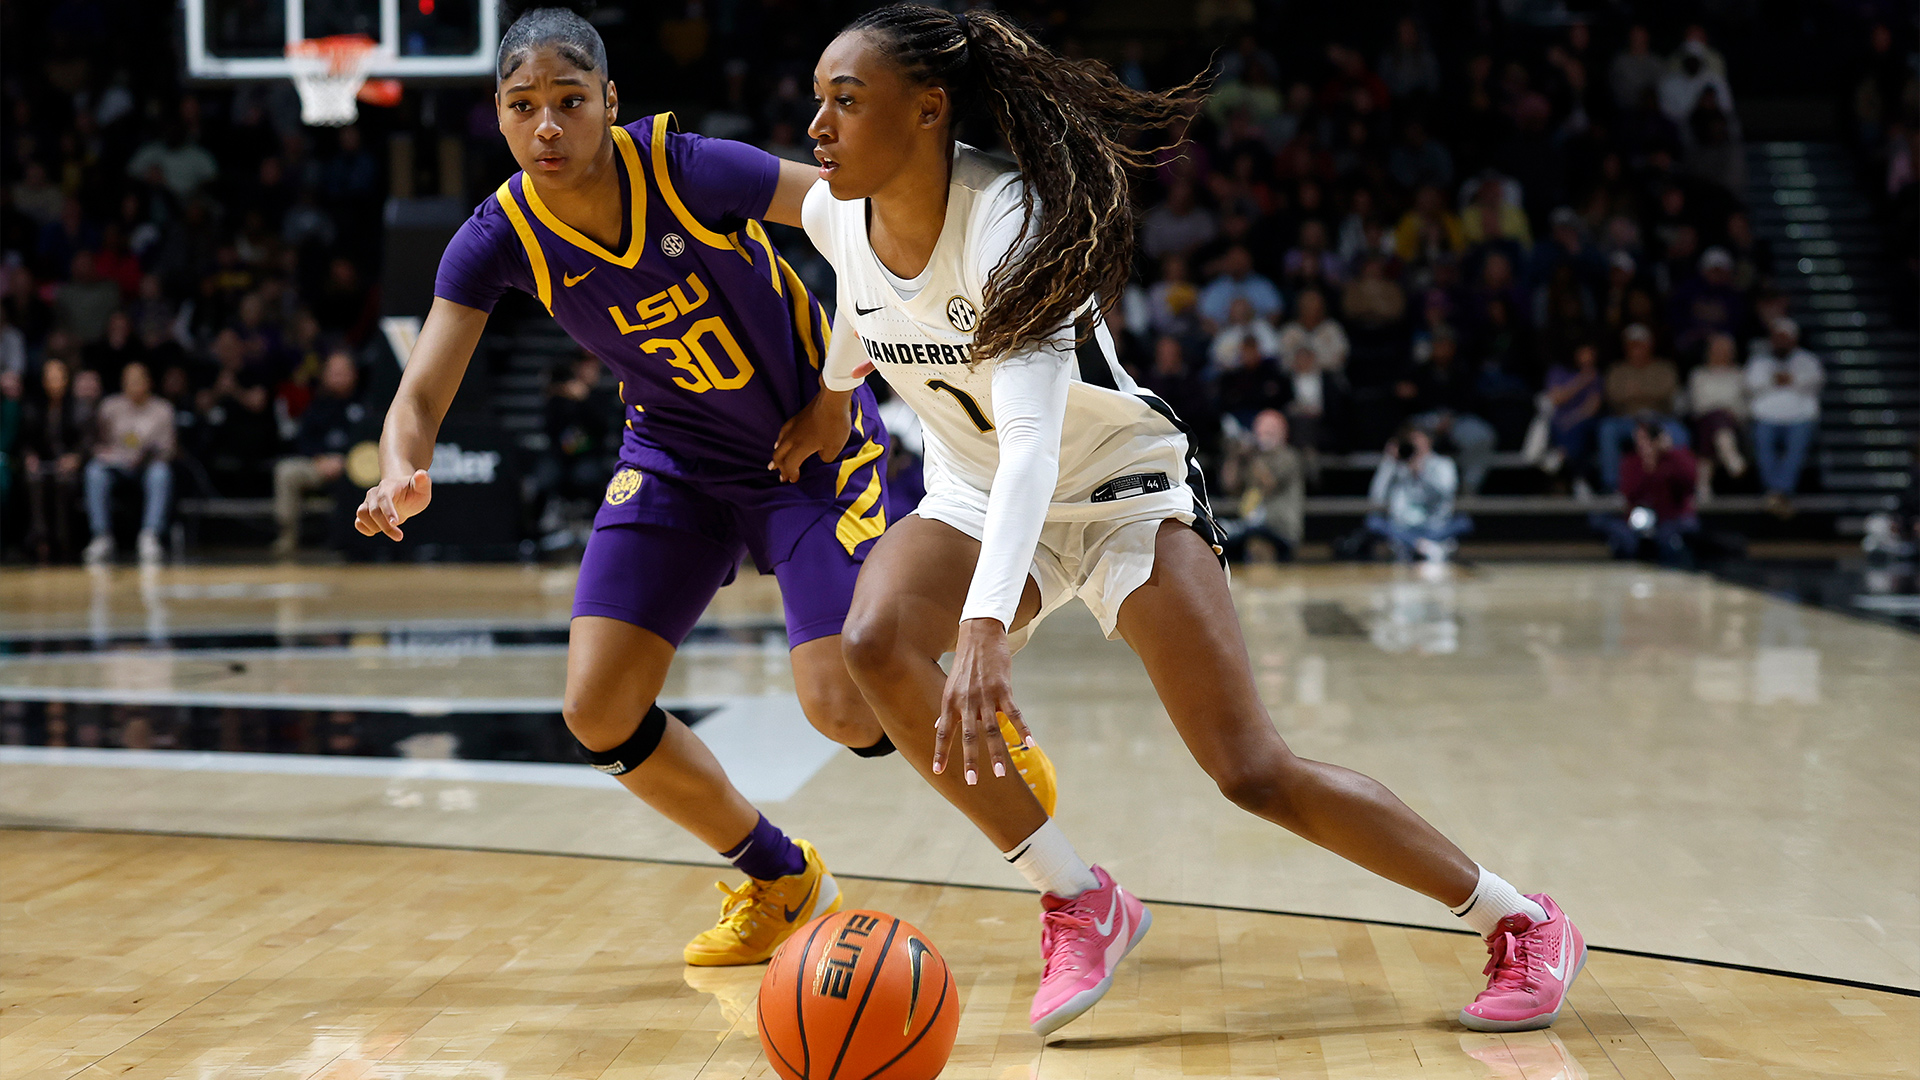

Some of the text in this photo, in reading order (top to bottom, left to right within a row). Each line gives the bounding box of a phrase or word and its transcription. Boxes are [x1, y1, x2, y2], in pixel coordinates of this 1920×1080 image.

[663, 235, 683, 255] SEC
[607, 272, 710, 335] LSU
[948, 298, 977, 332] SEC
[638, 315, 756, 394] 30
[861, 335, 972, 365] VANDERBI
[924, 378, 996, 434] 1
[1147, 479, 1159, 489] 44
[819, 914, 880, 1000] ELITE
